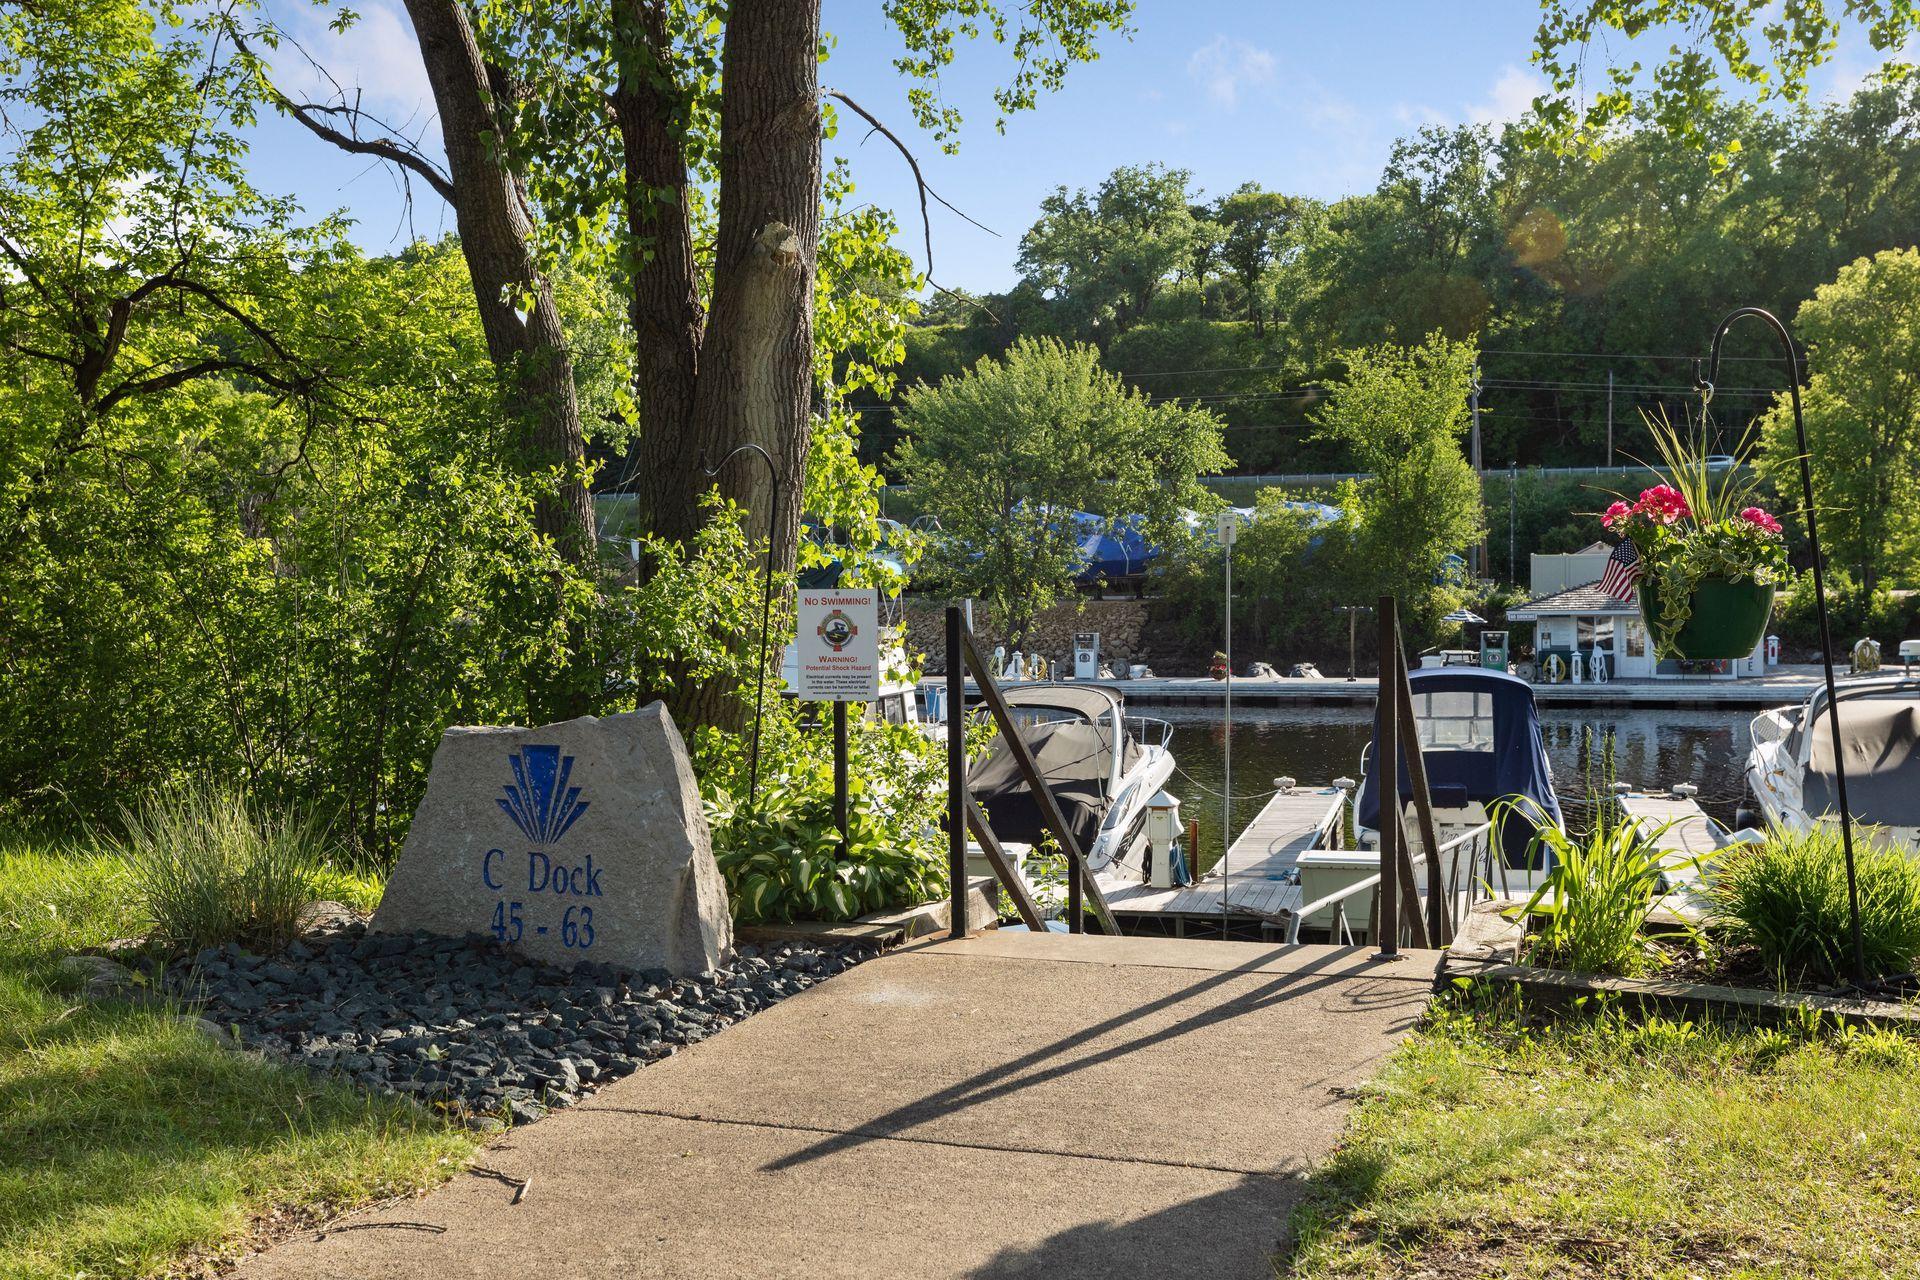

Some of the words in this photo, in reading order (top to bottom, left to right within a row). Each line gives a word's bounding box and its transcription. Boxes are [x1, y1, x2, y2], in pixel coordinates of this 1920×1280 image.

[804, 597, 819, 606] NO
[820, 597, 871, 606] SWIMMING!
[483, 848, 505, 890] C
[527, 851, 603, 897] Dock
[491, 901, 524, 943] 45
[537, 927, 548, 935] -
[561, 905, 595, 948] 63
